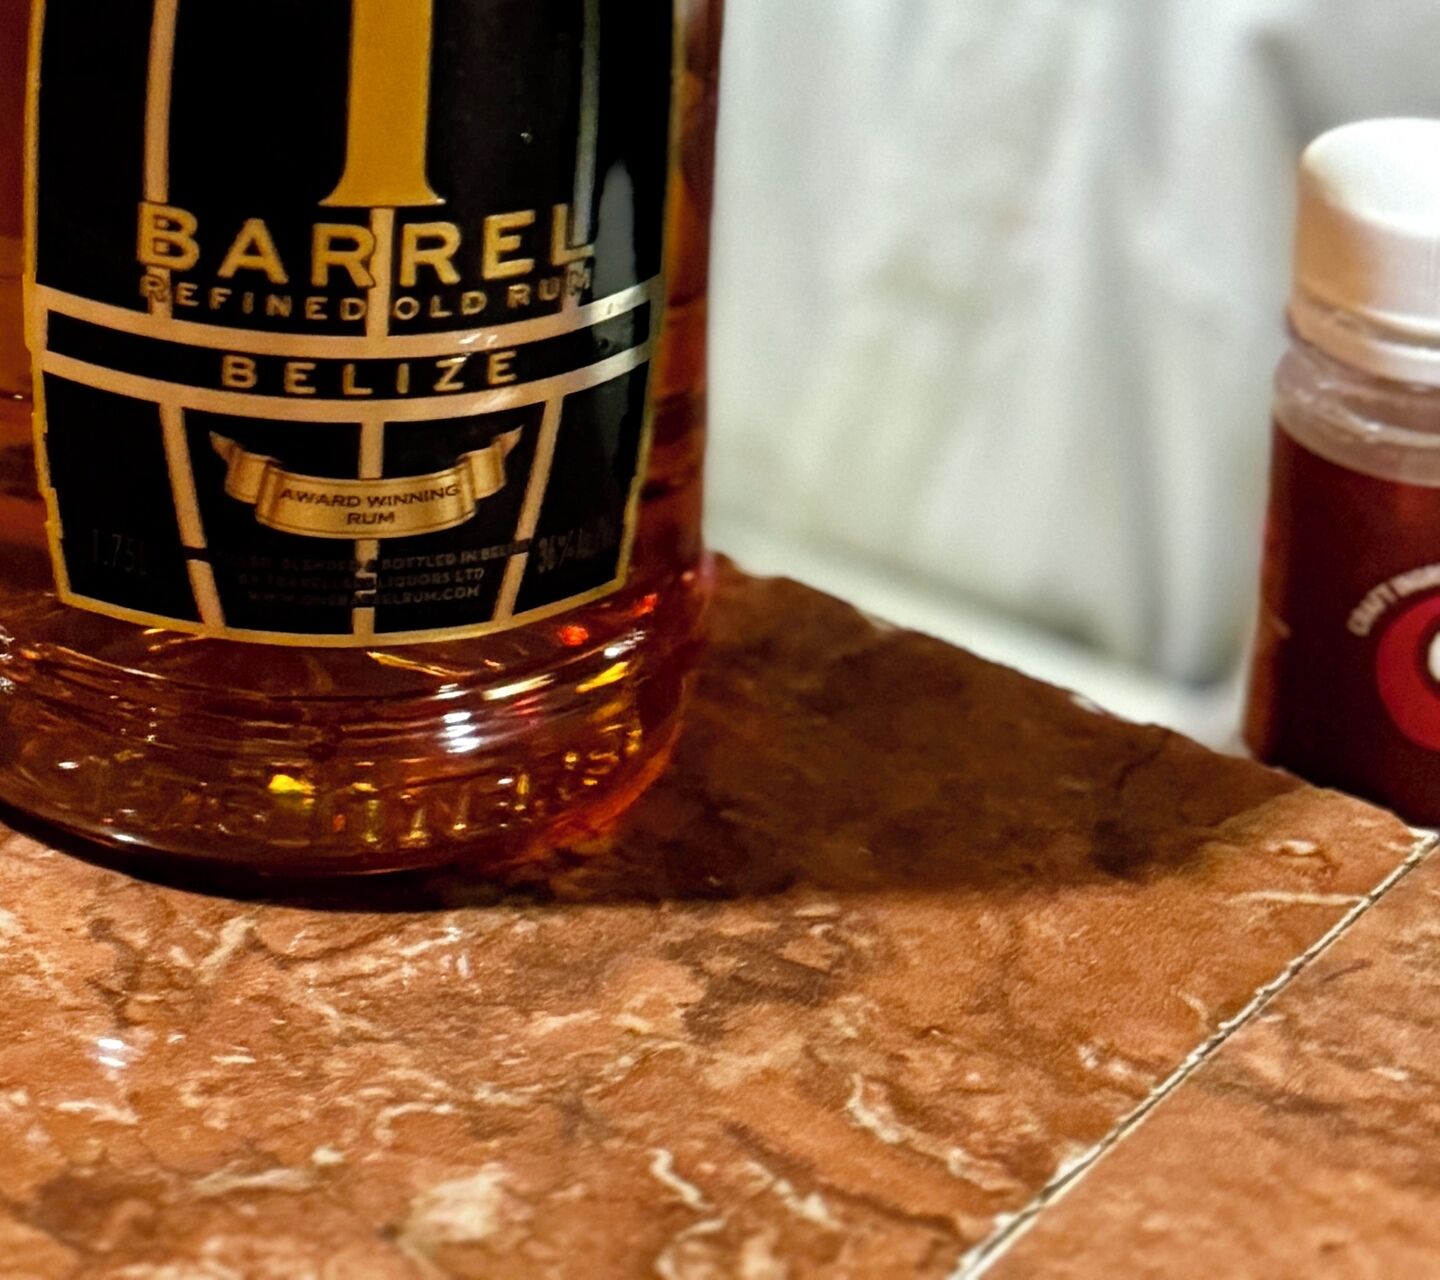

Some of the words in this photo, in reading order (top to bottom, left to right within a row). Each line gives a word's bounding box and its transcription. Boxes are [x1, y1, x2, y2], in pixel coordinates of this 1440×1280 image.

[137, 202, 595, 288] BARREL
[140, 274, 367, 321] REFINED
[394, 290, 487, 320] OLD
[507, 268, 591, 308] RUM
[220, 350, 517, 396] BELIZE
[280, 489, 361, 508] AWARD
[366, 483, 460, 507] WINNING
[346, 511, 396, 525] RUM
[381, 552, 456, 570] BOTTLED
[460, 549, 479, 565] IN
[378, 571, 450, 589] LIQUORS
[455, 567, 485, 583] LTD
